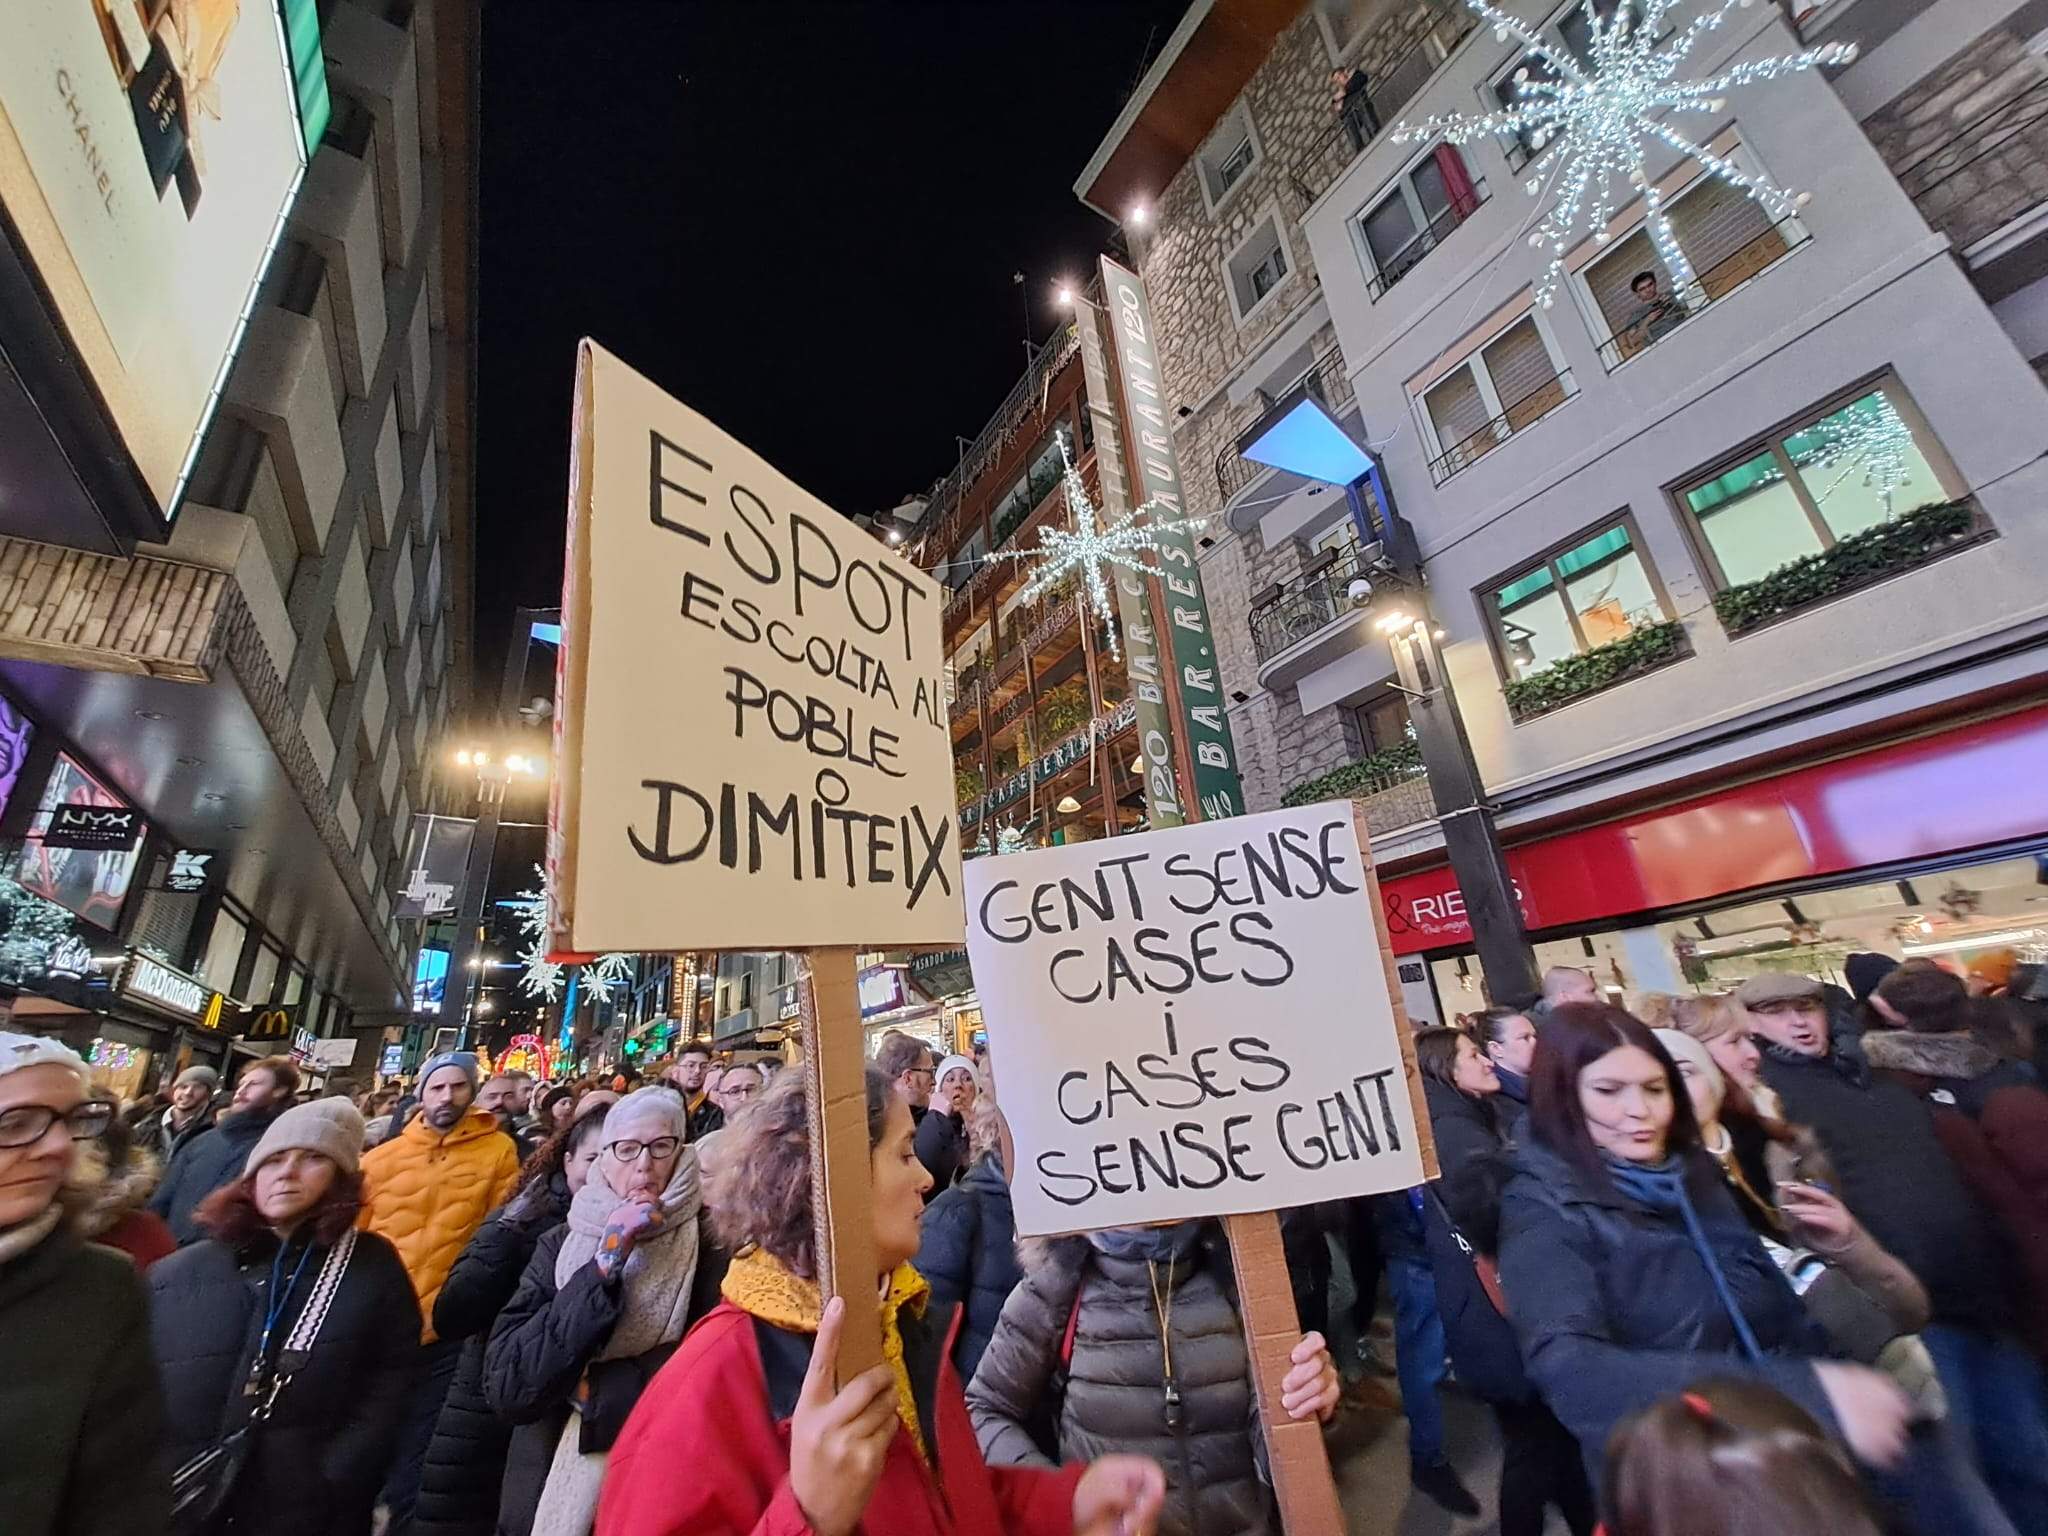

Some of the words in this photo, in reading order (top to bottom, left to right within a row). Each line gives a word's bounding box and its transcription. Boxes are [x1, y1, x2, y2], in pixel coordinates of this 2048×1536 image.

[57, 68, 115, 217] CHANEL
[1083, 326, 1110, 383] 120
[1118, 283, 1148, 345] 120
[649, 428, 927, 661] ESPOT
[680, 570, 900, 711] ESCOLTA
[912, 676, 945, 732] AL
[723, 665, 908, 778] POBLE
[61, 808, 133, 829] NYX
[814, 767, 851, 806] O
[1145, 729, 1179, 819] 120
[978, 852, 1150, 944] GENT
[1163, 821, 1360, 915] SENSE
[1049, 911, 1295, 1004] CASES
[1056, 1036, 1292, 1126] CASES
[1036, 1114, 1267, 1206] SENSE
[1275, 1067, 1403, 1171] GENT
